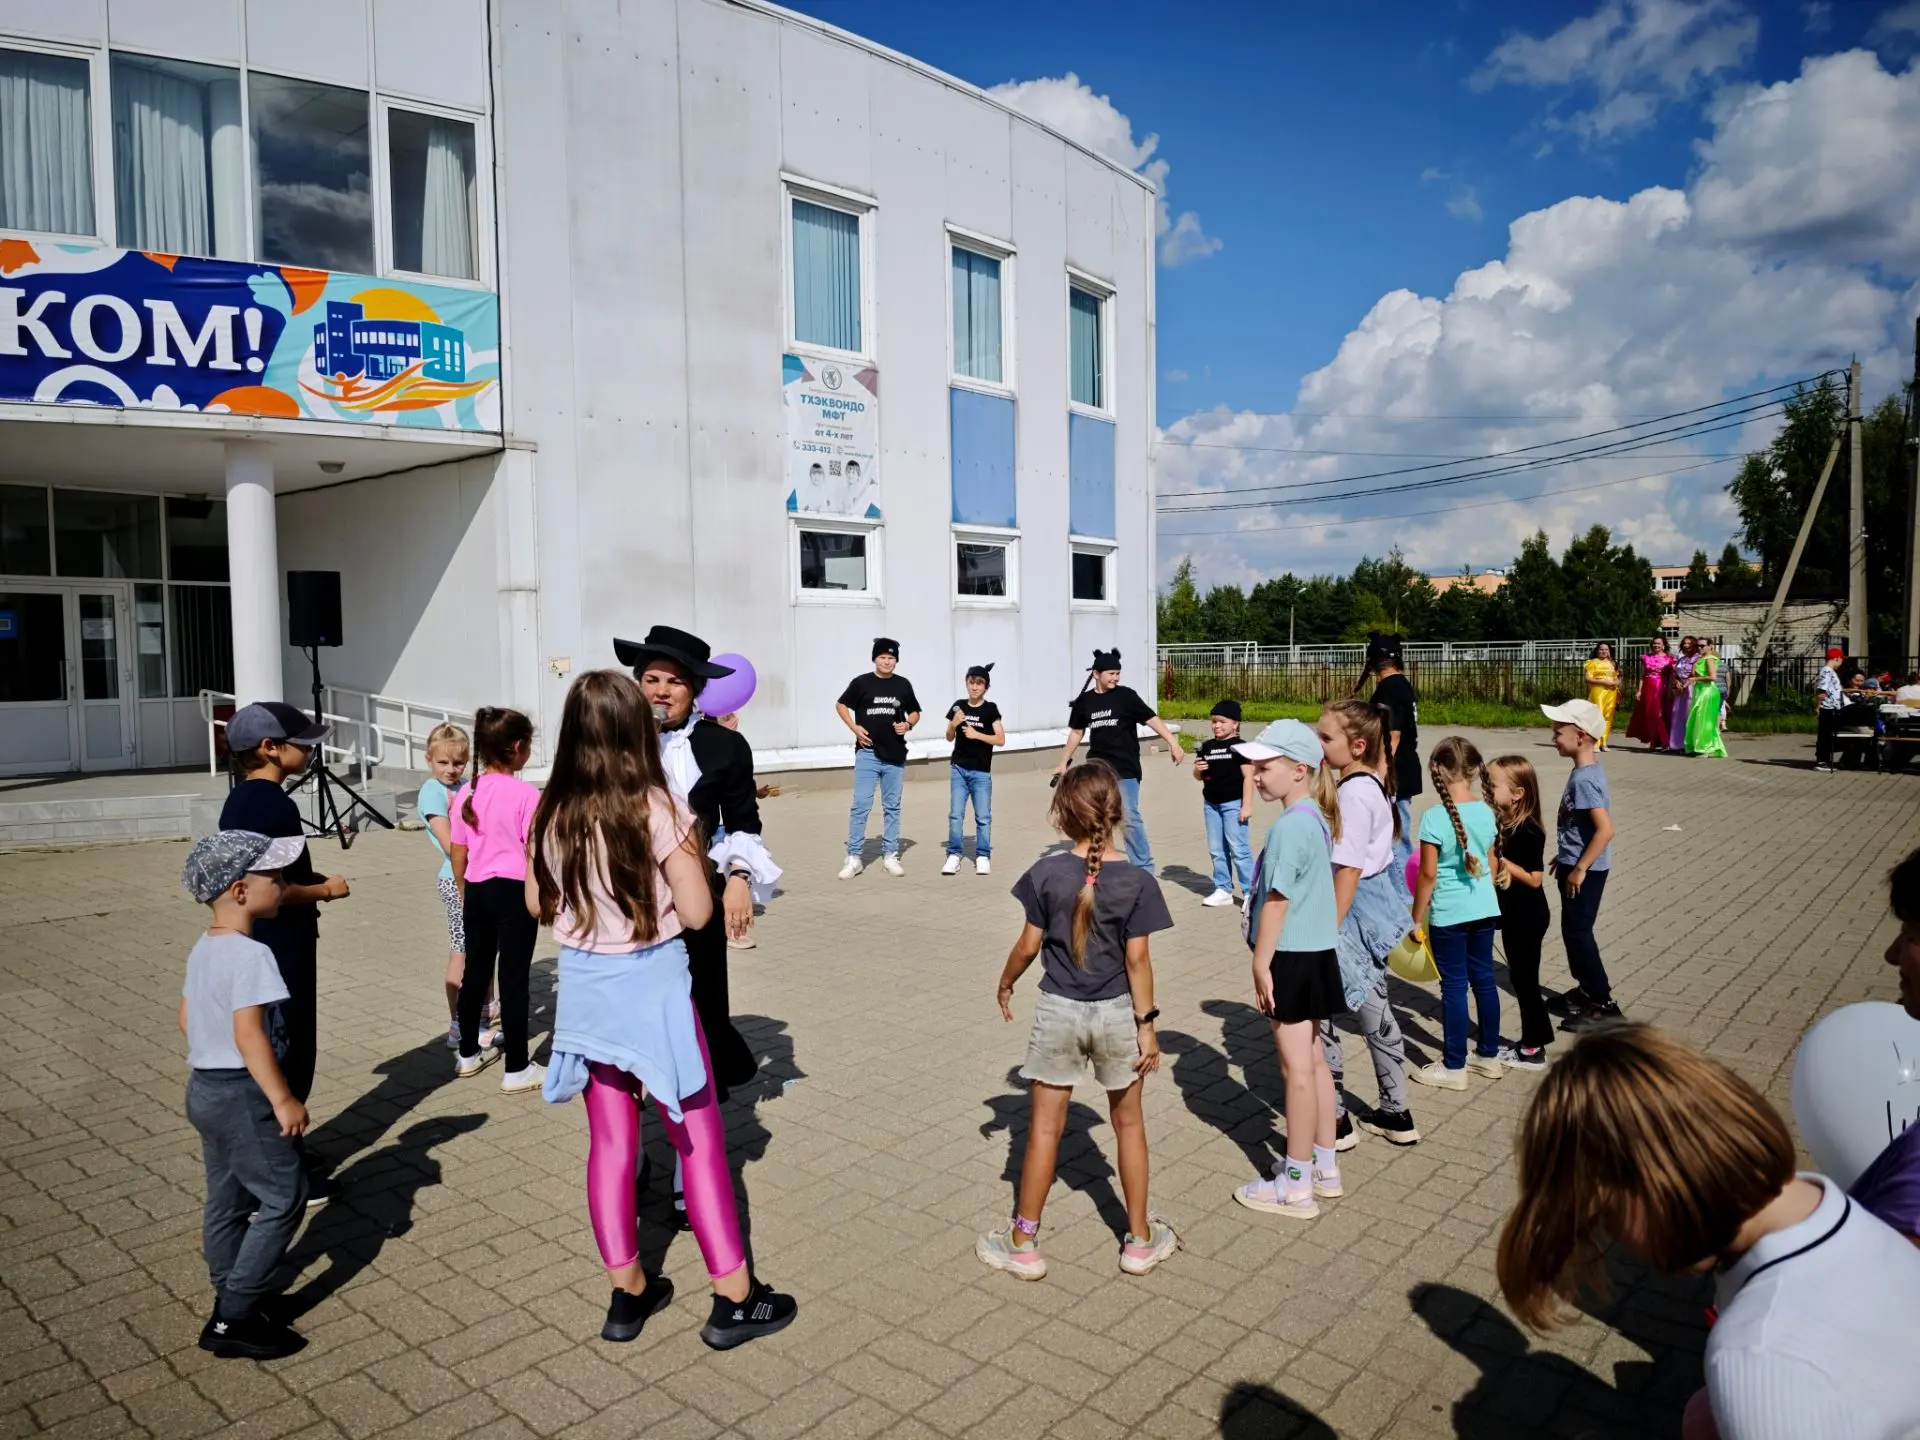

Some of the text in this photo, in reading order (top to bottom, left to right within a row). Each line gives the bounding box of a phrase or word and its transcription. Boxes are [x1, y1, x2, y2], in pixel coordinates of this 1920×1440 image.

[0, 286, 265, 373] КОМ!
[800, 394, 865, 412] ТХЭКВОНДО
[822, 409, 846, 421] МФТ
[840, 433, 854, 441] лет
[802, 444, 831, 454] 333-412
